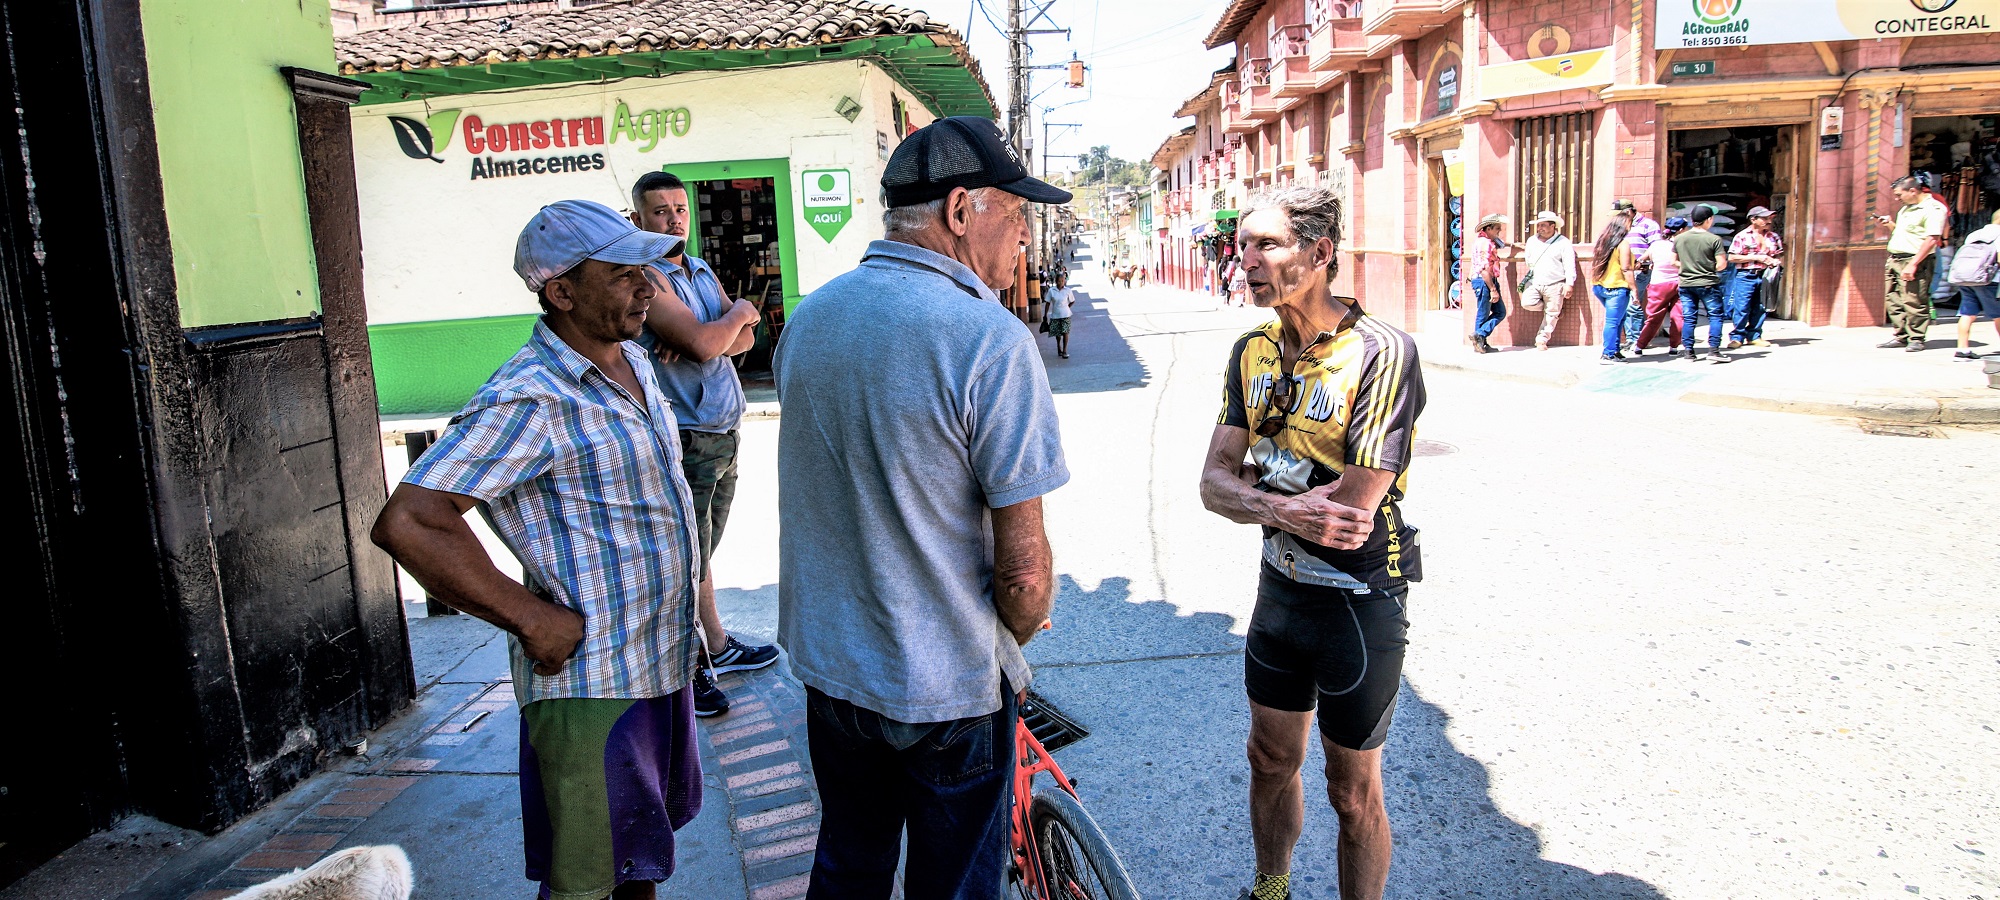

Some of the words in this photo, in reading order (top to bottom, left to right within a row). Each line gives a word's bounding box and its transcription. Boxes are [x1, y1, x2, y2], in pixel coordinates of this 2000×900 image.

[1682, 18, 1749, 35] AGROURRAO
[1875, 15, 1990, 34] CONTEGRAL
[1682, 38, 1699, 46] Tel:
[1701, 37, 1721, 46] 850
[1723, 35, 1748, 45] 3661
[1694, 63, 1706, 74] 30
[470, 152, 605, 180] Almacenes
[813, 210, 842, 223] AQUÍ
